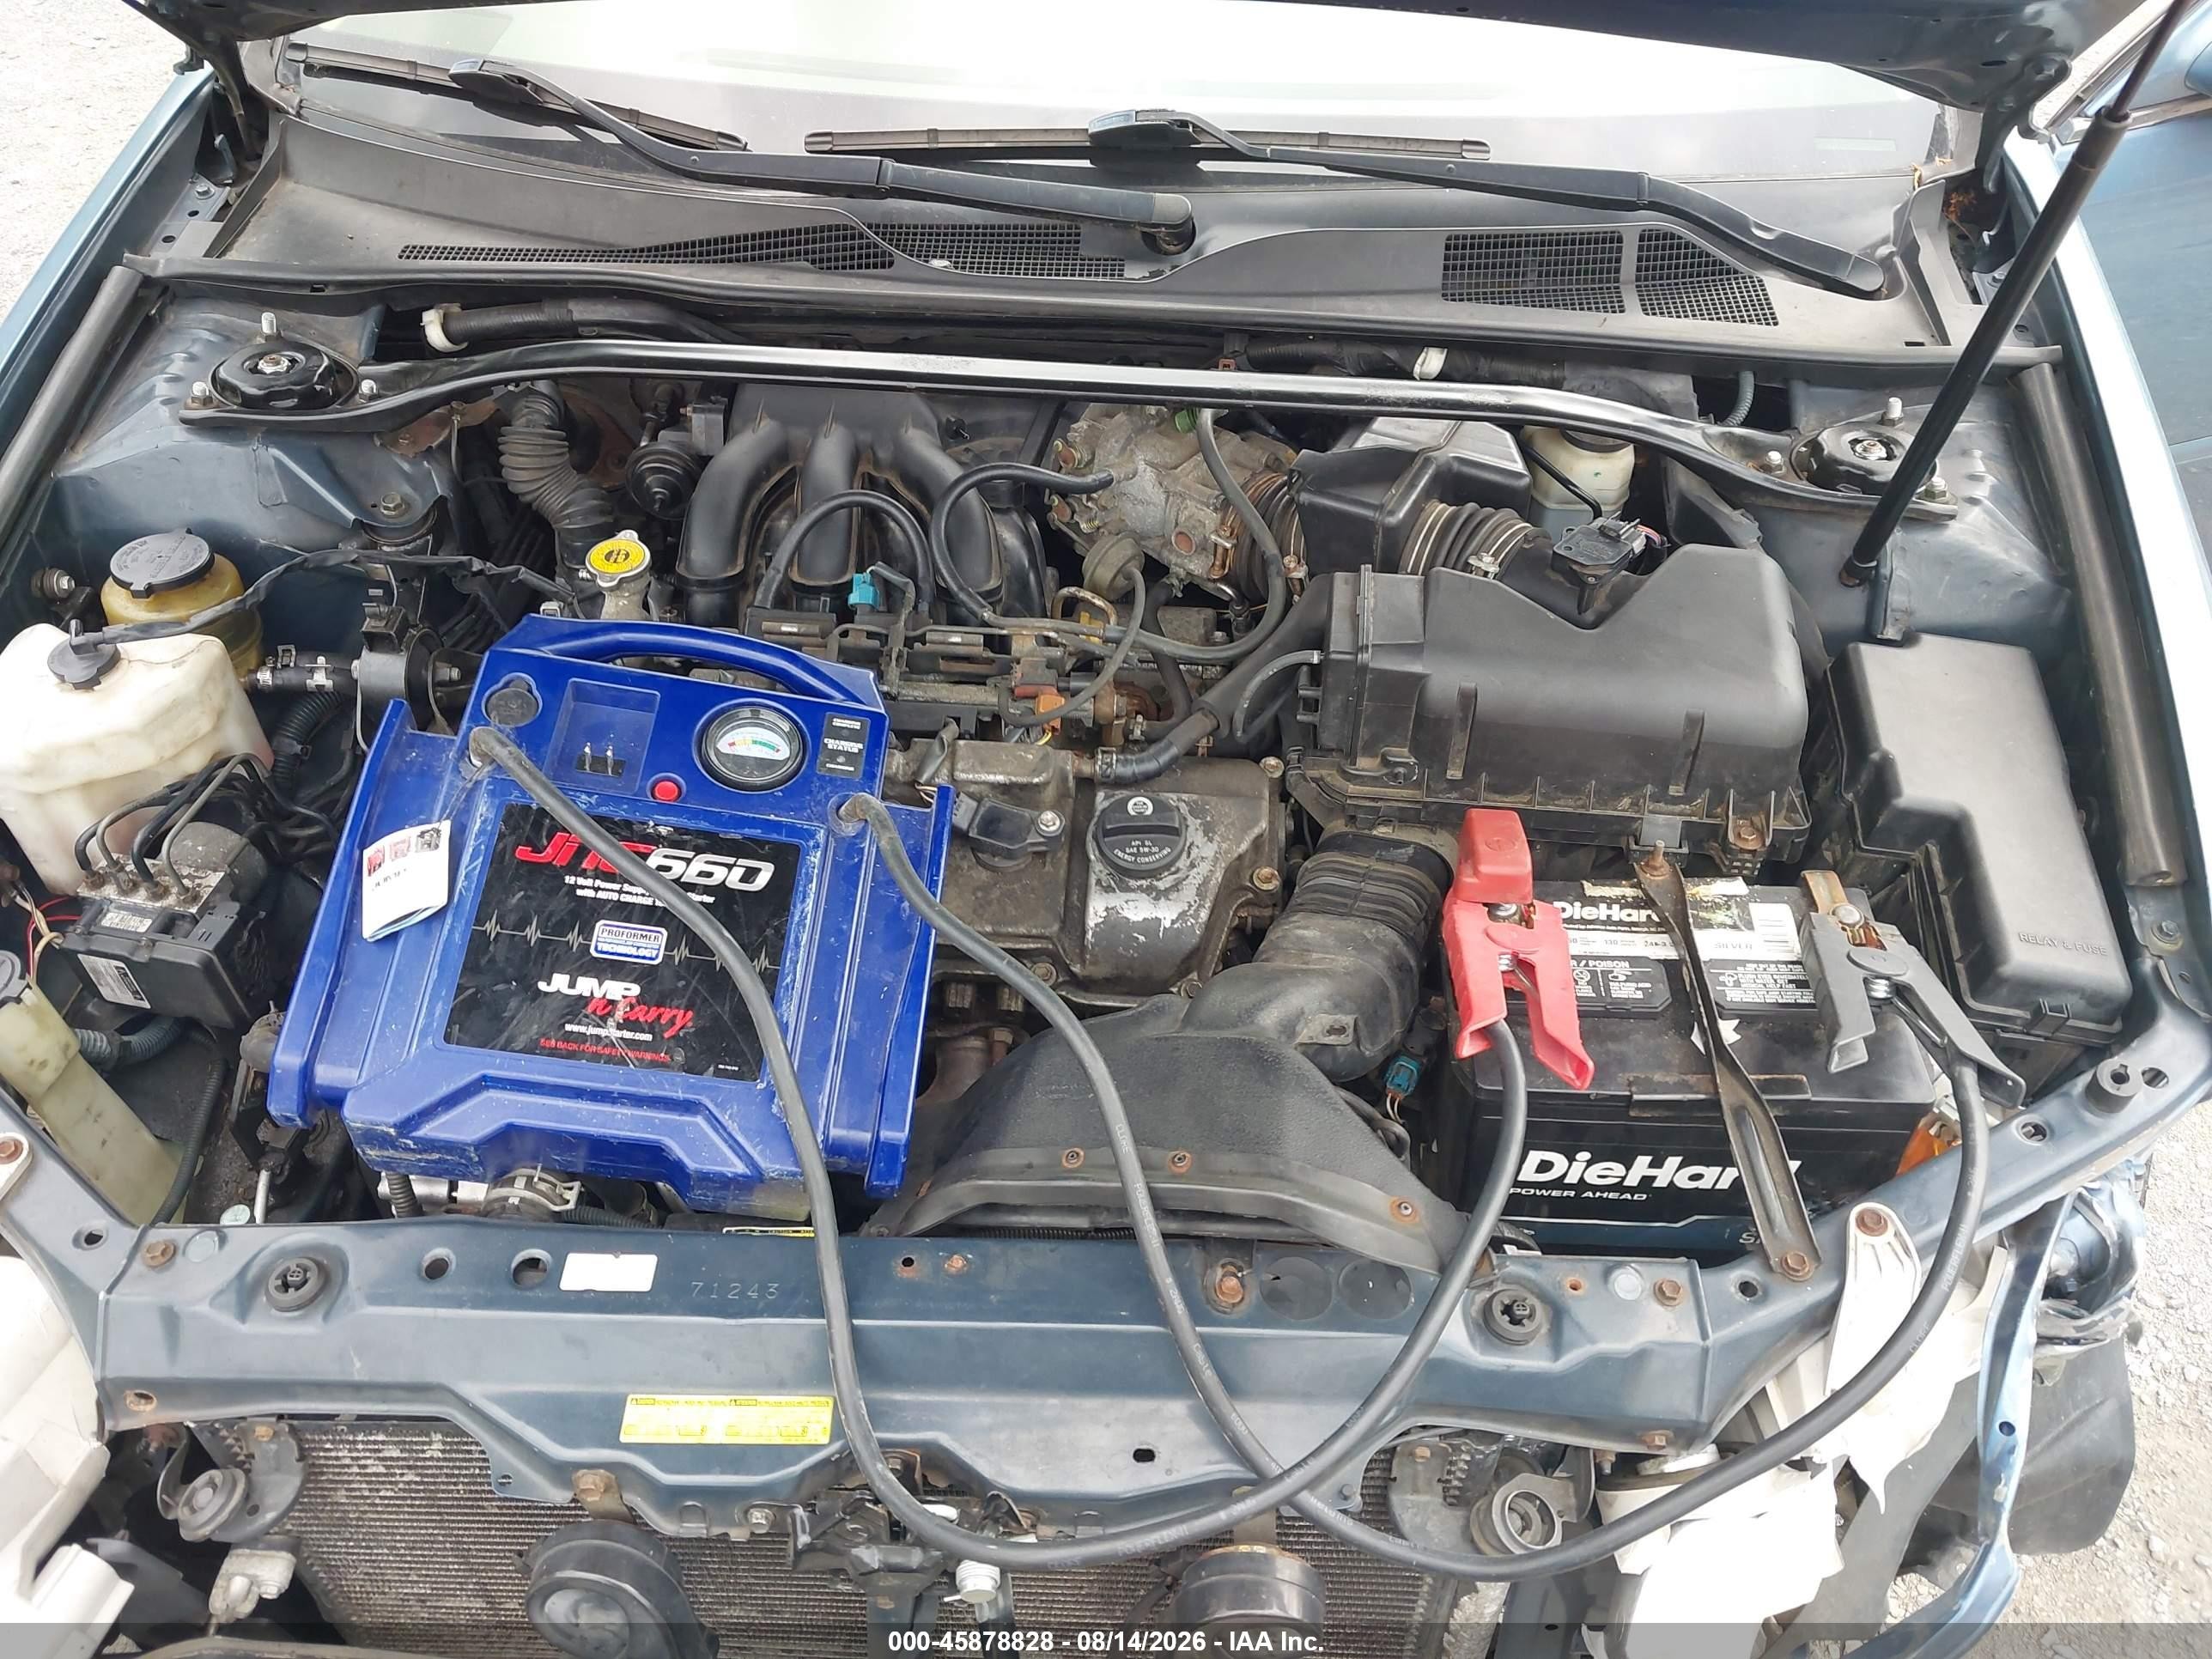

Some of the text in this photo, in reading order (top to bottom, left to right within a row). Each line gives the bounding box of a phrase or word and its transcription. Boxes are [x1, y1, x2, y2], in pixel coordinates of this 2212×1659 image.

[828, 744, 859, 753] STATUS
[1114, 847, 1171, 864] ENERGY CONSERVING
[564, 876, 576, 884] 12
[576, 877, 594, 887] Volt
[594, 879, 622, 890] Power
[575, 889, 596, 898] with
[596, 890, 619, 901] AUTO
[619, 893, 654, 905] CHARGE
[601, 927, 659, 943] PROFORMER
[2019, 932, 2109, 957] RELAY & FUSE
[1588, 959, 1631, 969] POISON
[538, 973, 641, 1001] JUMP
[556, 1040, 579, 1052] BACK
[579, 1042, 596, 1053] FOR
[1517, 1150, 1802, 1190] DieHar
[1509, 1188, 1648, 1201] POWER AHEAD
[690, 1282, 780, 1299] 71243
